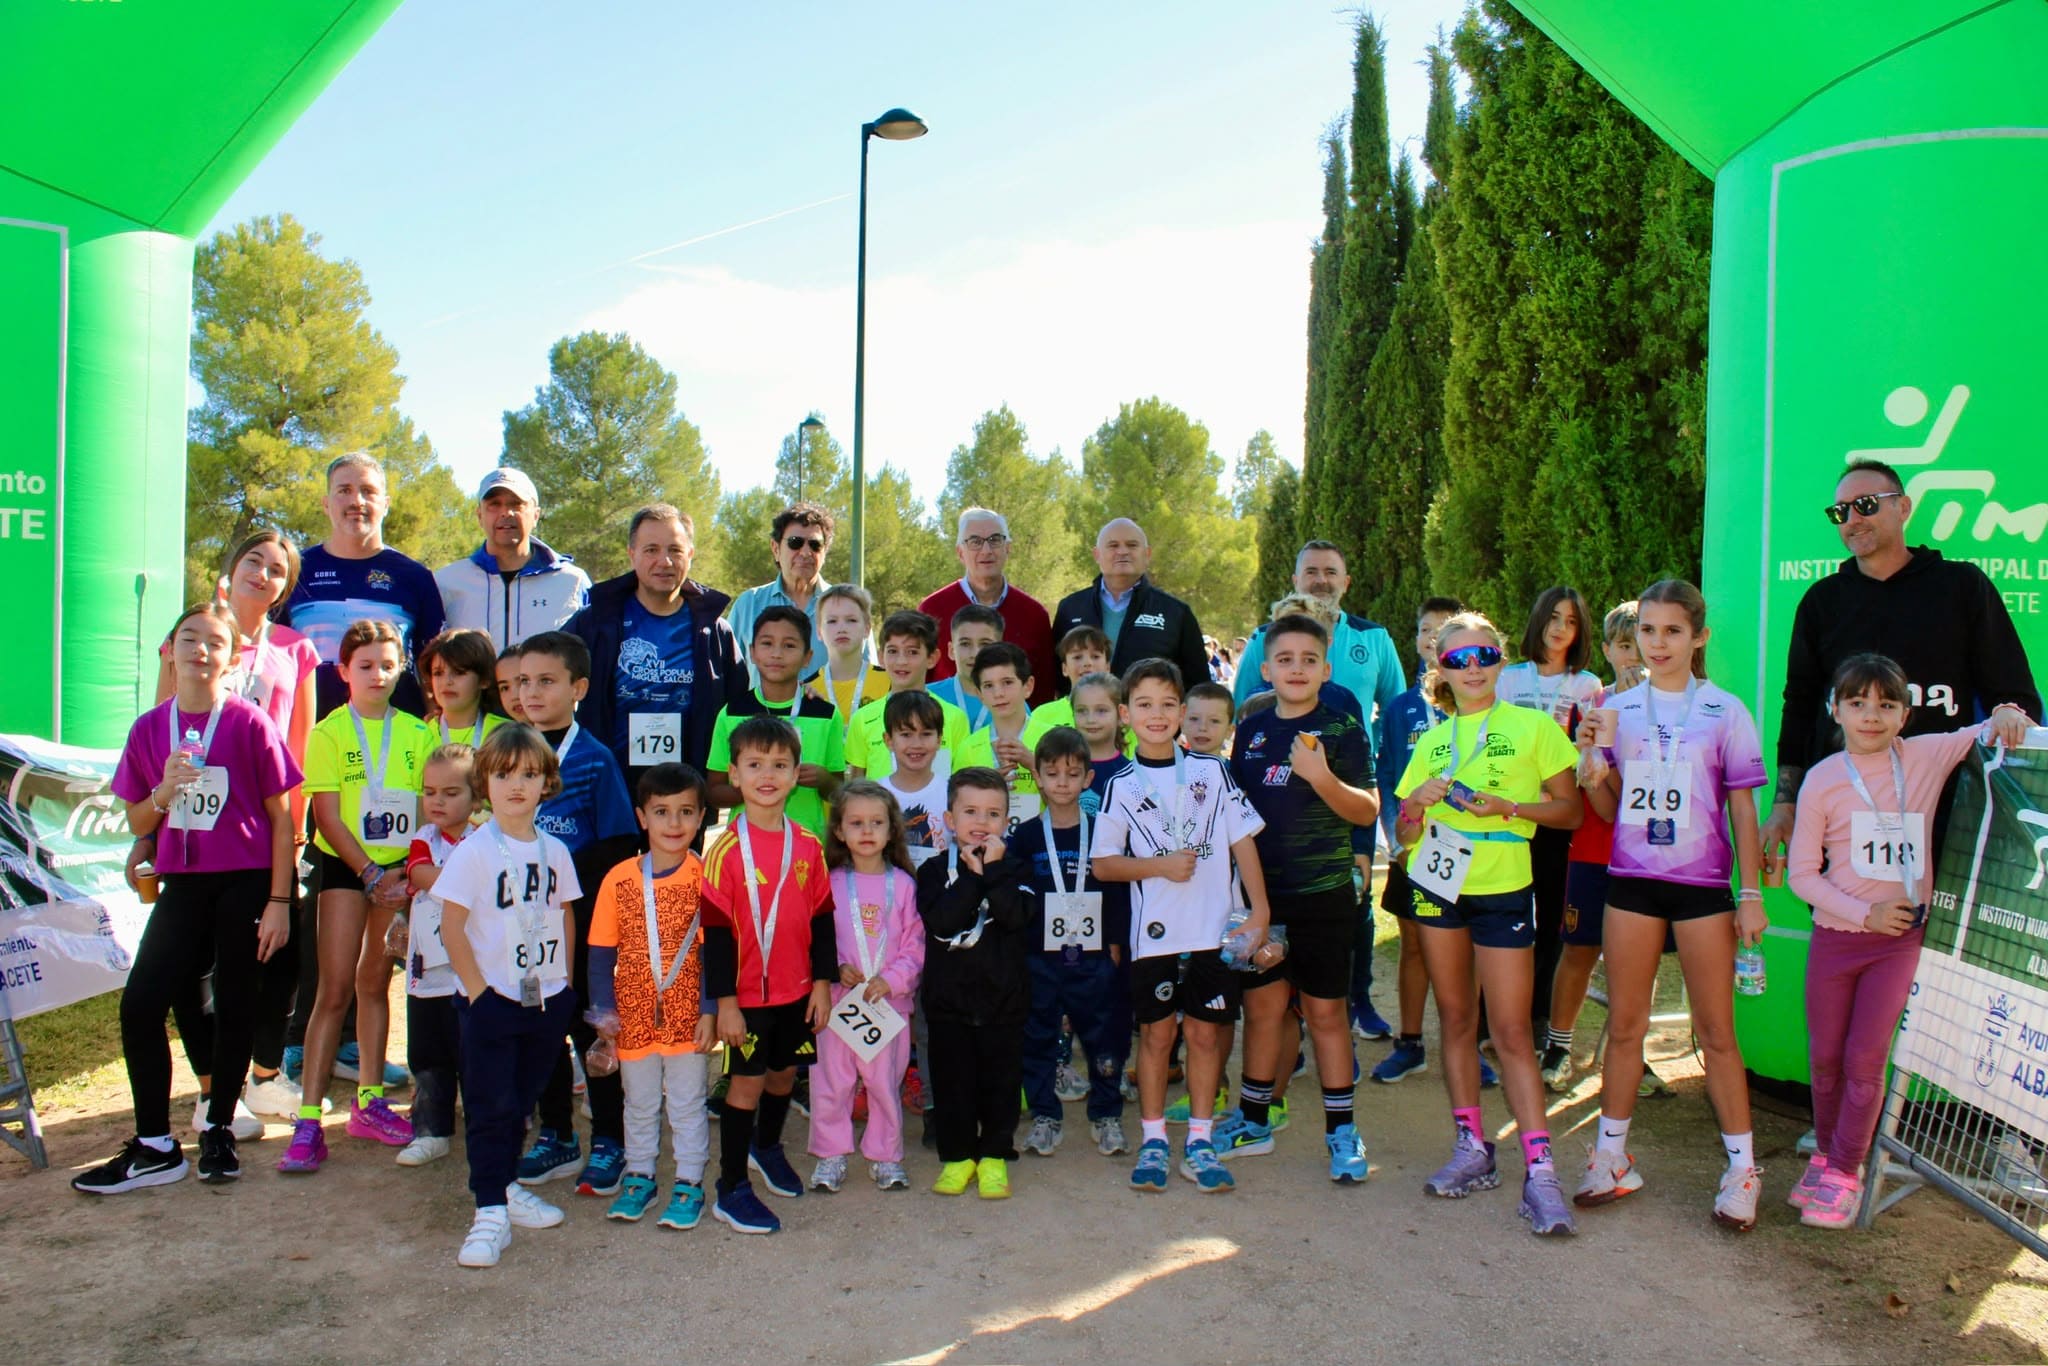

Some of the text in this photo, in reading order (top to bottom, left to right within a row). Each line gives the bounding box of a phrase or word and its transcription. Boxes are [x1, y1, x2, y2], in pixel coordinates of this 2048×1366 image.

[1779, 558, 1848, 580] INSTIT
[631, 672, 693, 684] MIGUEL SALCED
[632, 666, 659, 676] CROSS
[636, 735, 676, 754] 179
[365, 811, 409, 835] 90
[1862, 840, 1914, 866] 118
[1427, 850, 1455, 880] 33
[1052, 916, 1095, 937] 83
[1978, 903, 2026, 932] INSTITUTO
[838, 1003, 882, 1046] 279
